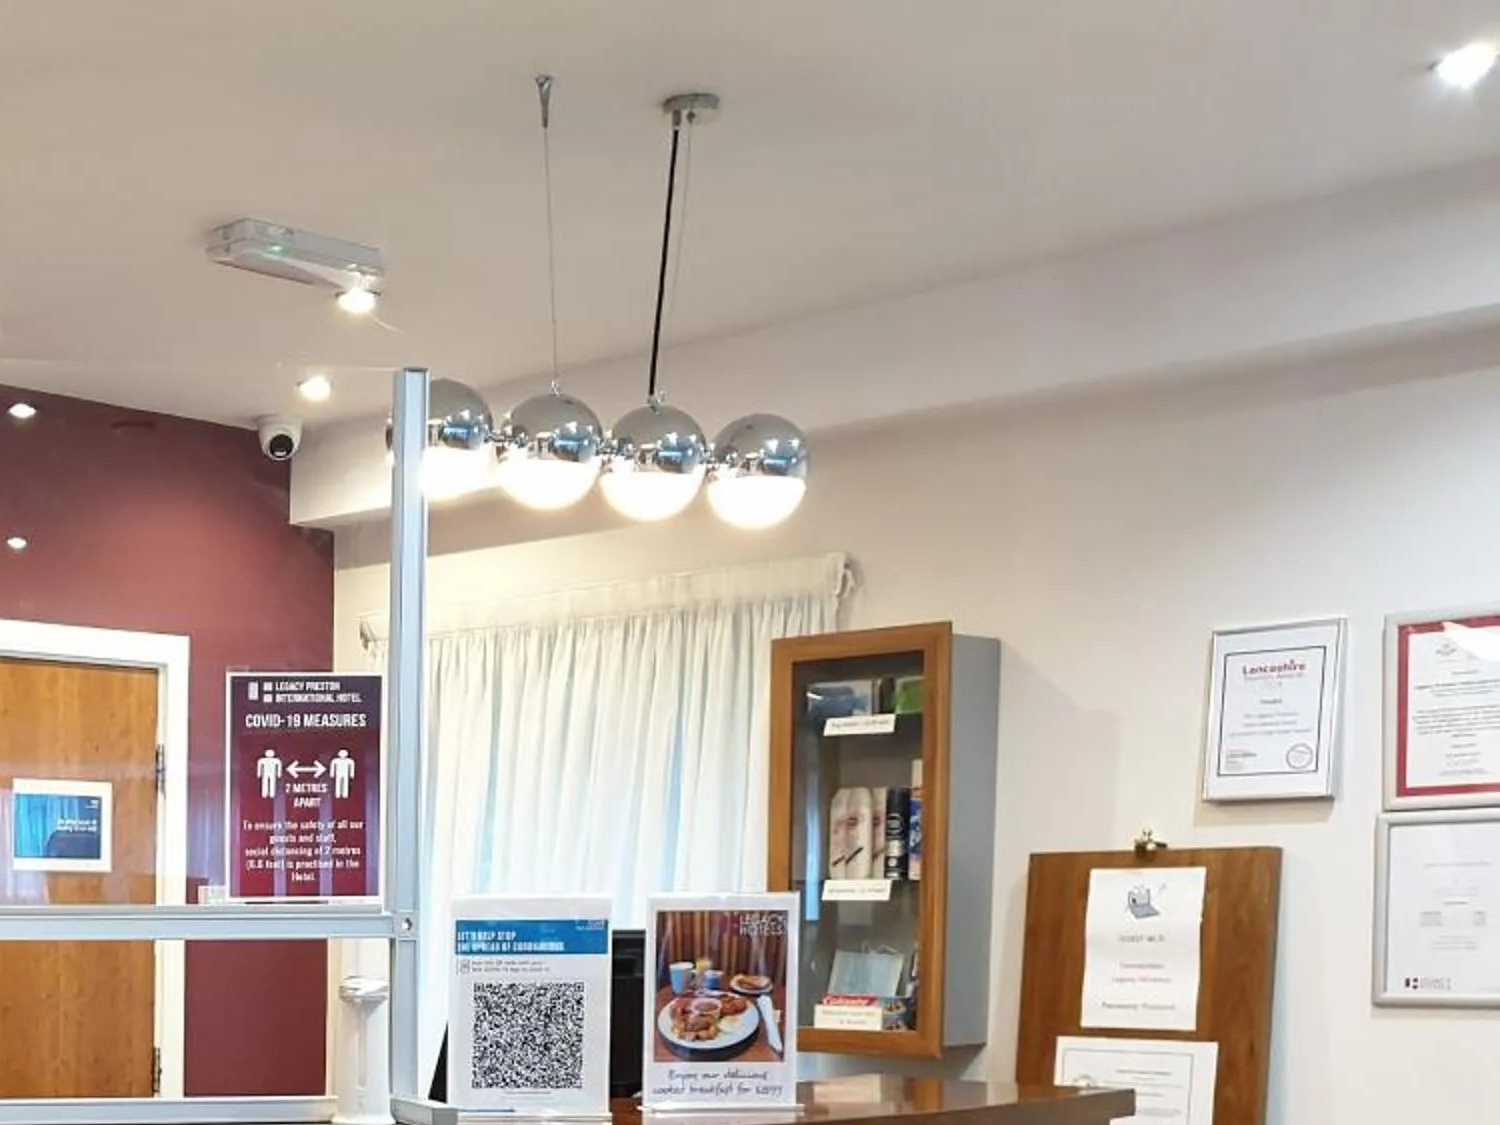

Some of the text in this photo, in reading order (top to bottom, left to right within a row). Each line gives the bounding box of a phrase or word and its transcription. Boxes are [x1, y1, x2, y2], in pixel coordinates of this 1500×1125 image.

[276, 681, 304, 691] LEGACY
[245, 713, 367, 727] COVID-19 MEASURES
[293, 783, 328, 794] METRES
[294, 796, 321, 807] APART
